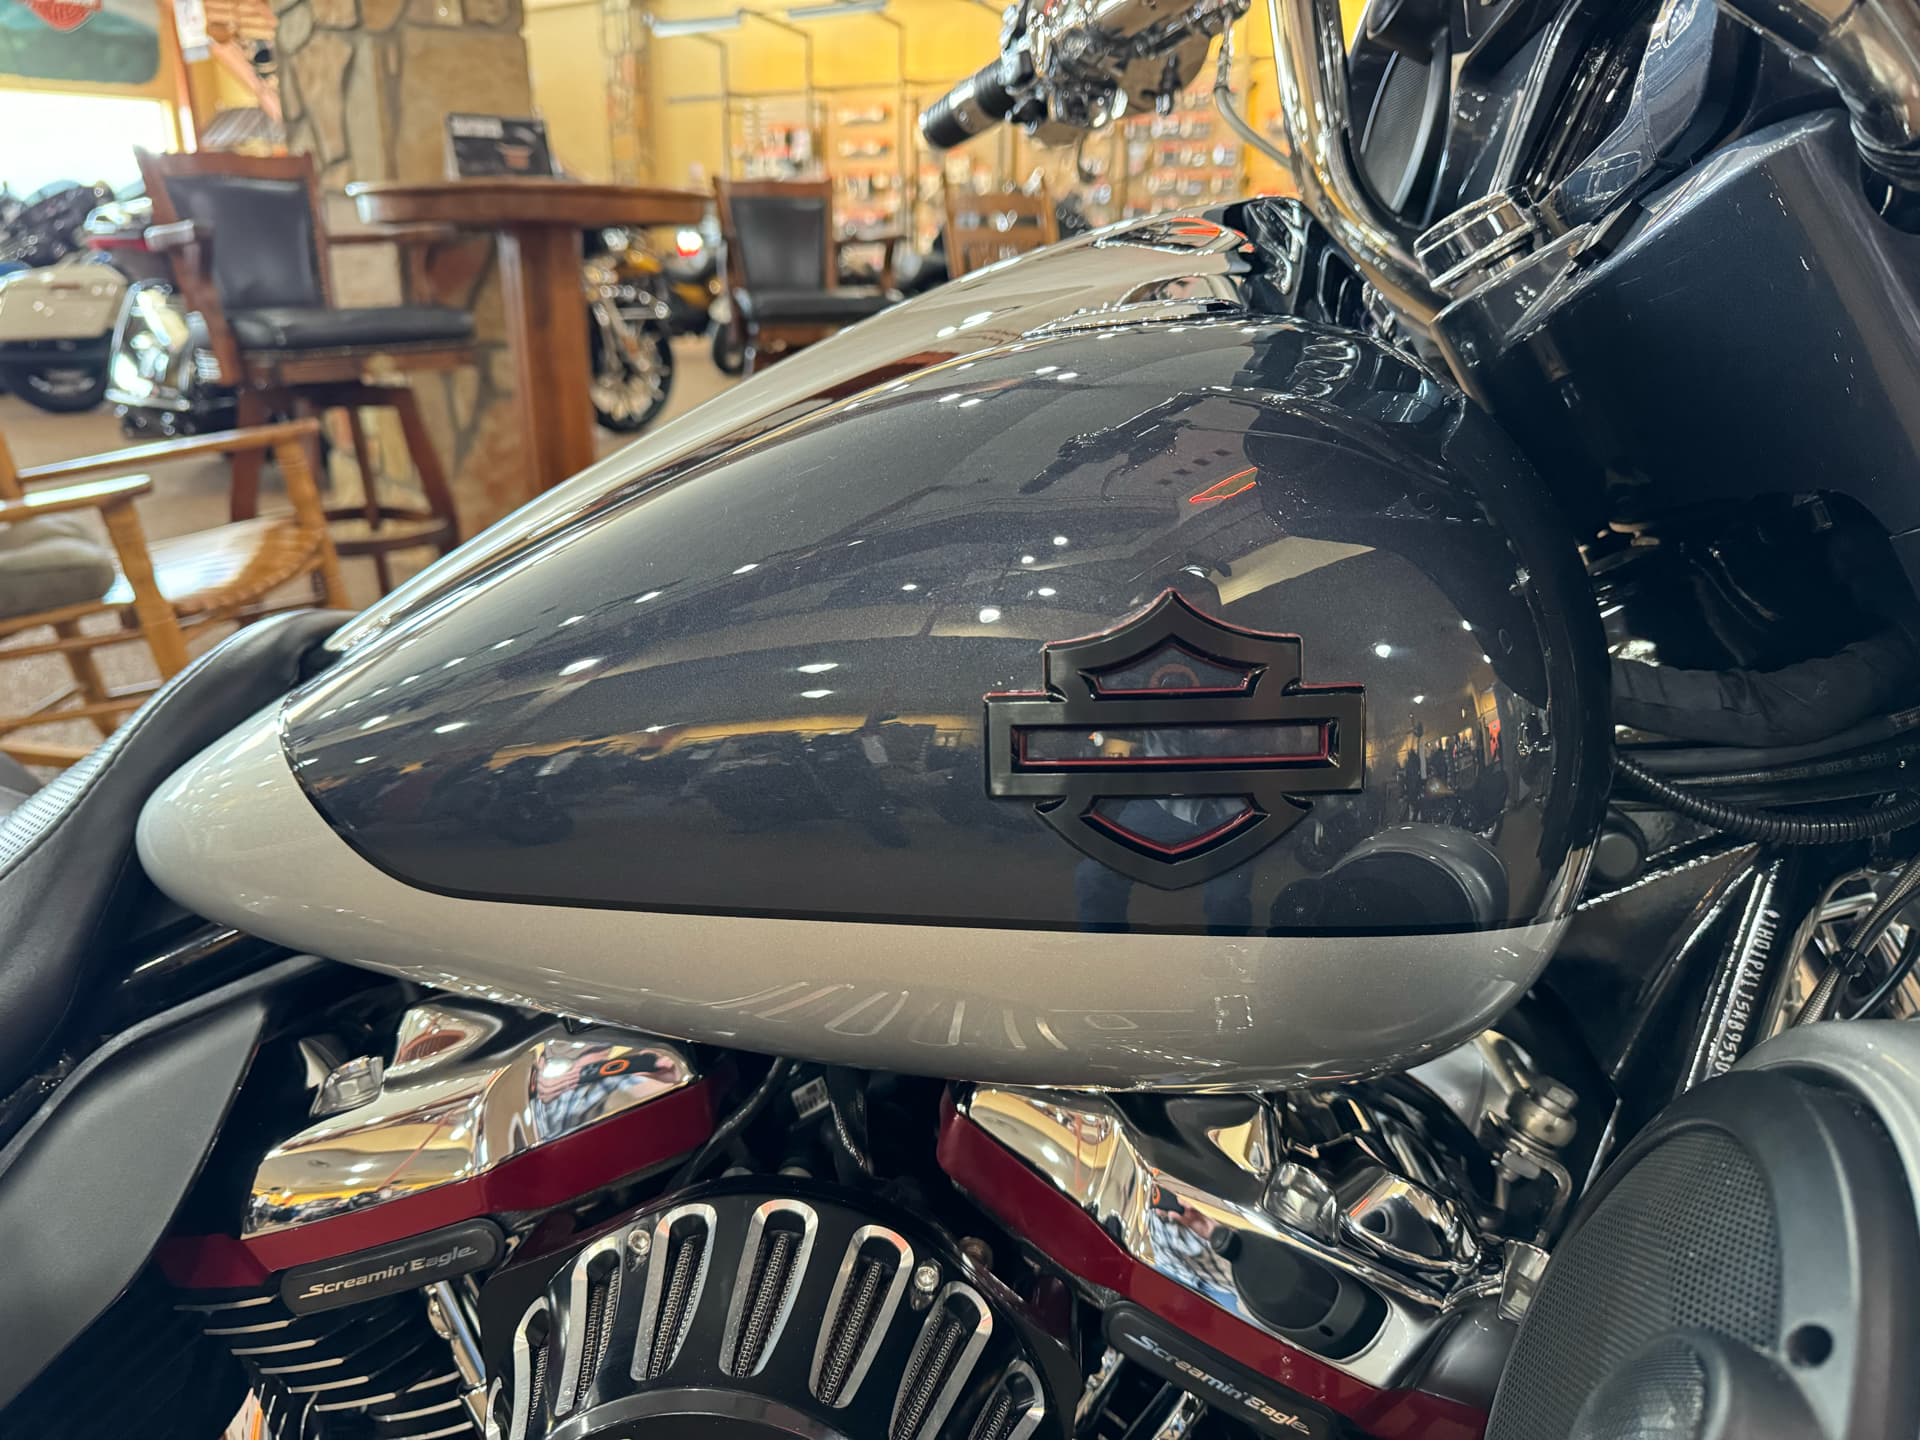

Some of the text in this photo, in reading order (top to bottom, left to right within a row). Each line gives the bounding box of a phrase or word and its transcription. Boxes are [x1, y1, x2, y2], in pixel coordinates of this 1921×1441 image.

[1711, 920, 1777, 1077] 1HD1PXL15KB9530
[299, 1245, 478, 1299] Screamin' Eagle
[1123, 1332, 1311, 1435] Screamin' Eagle
